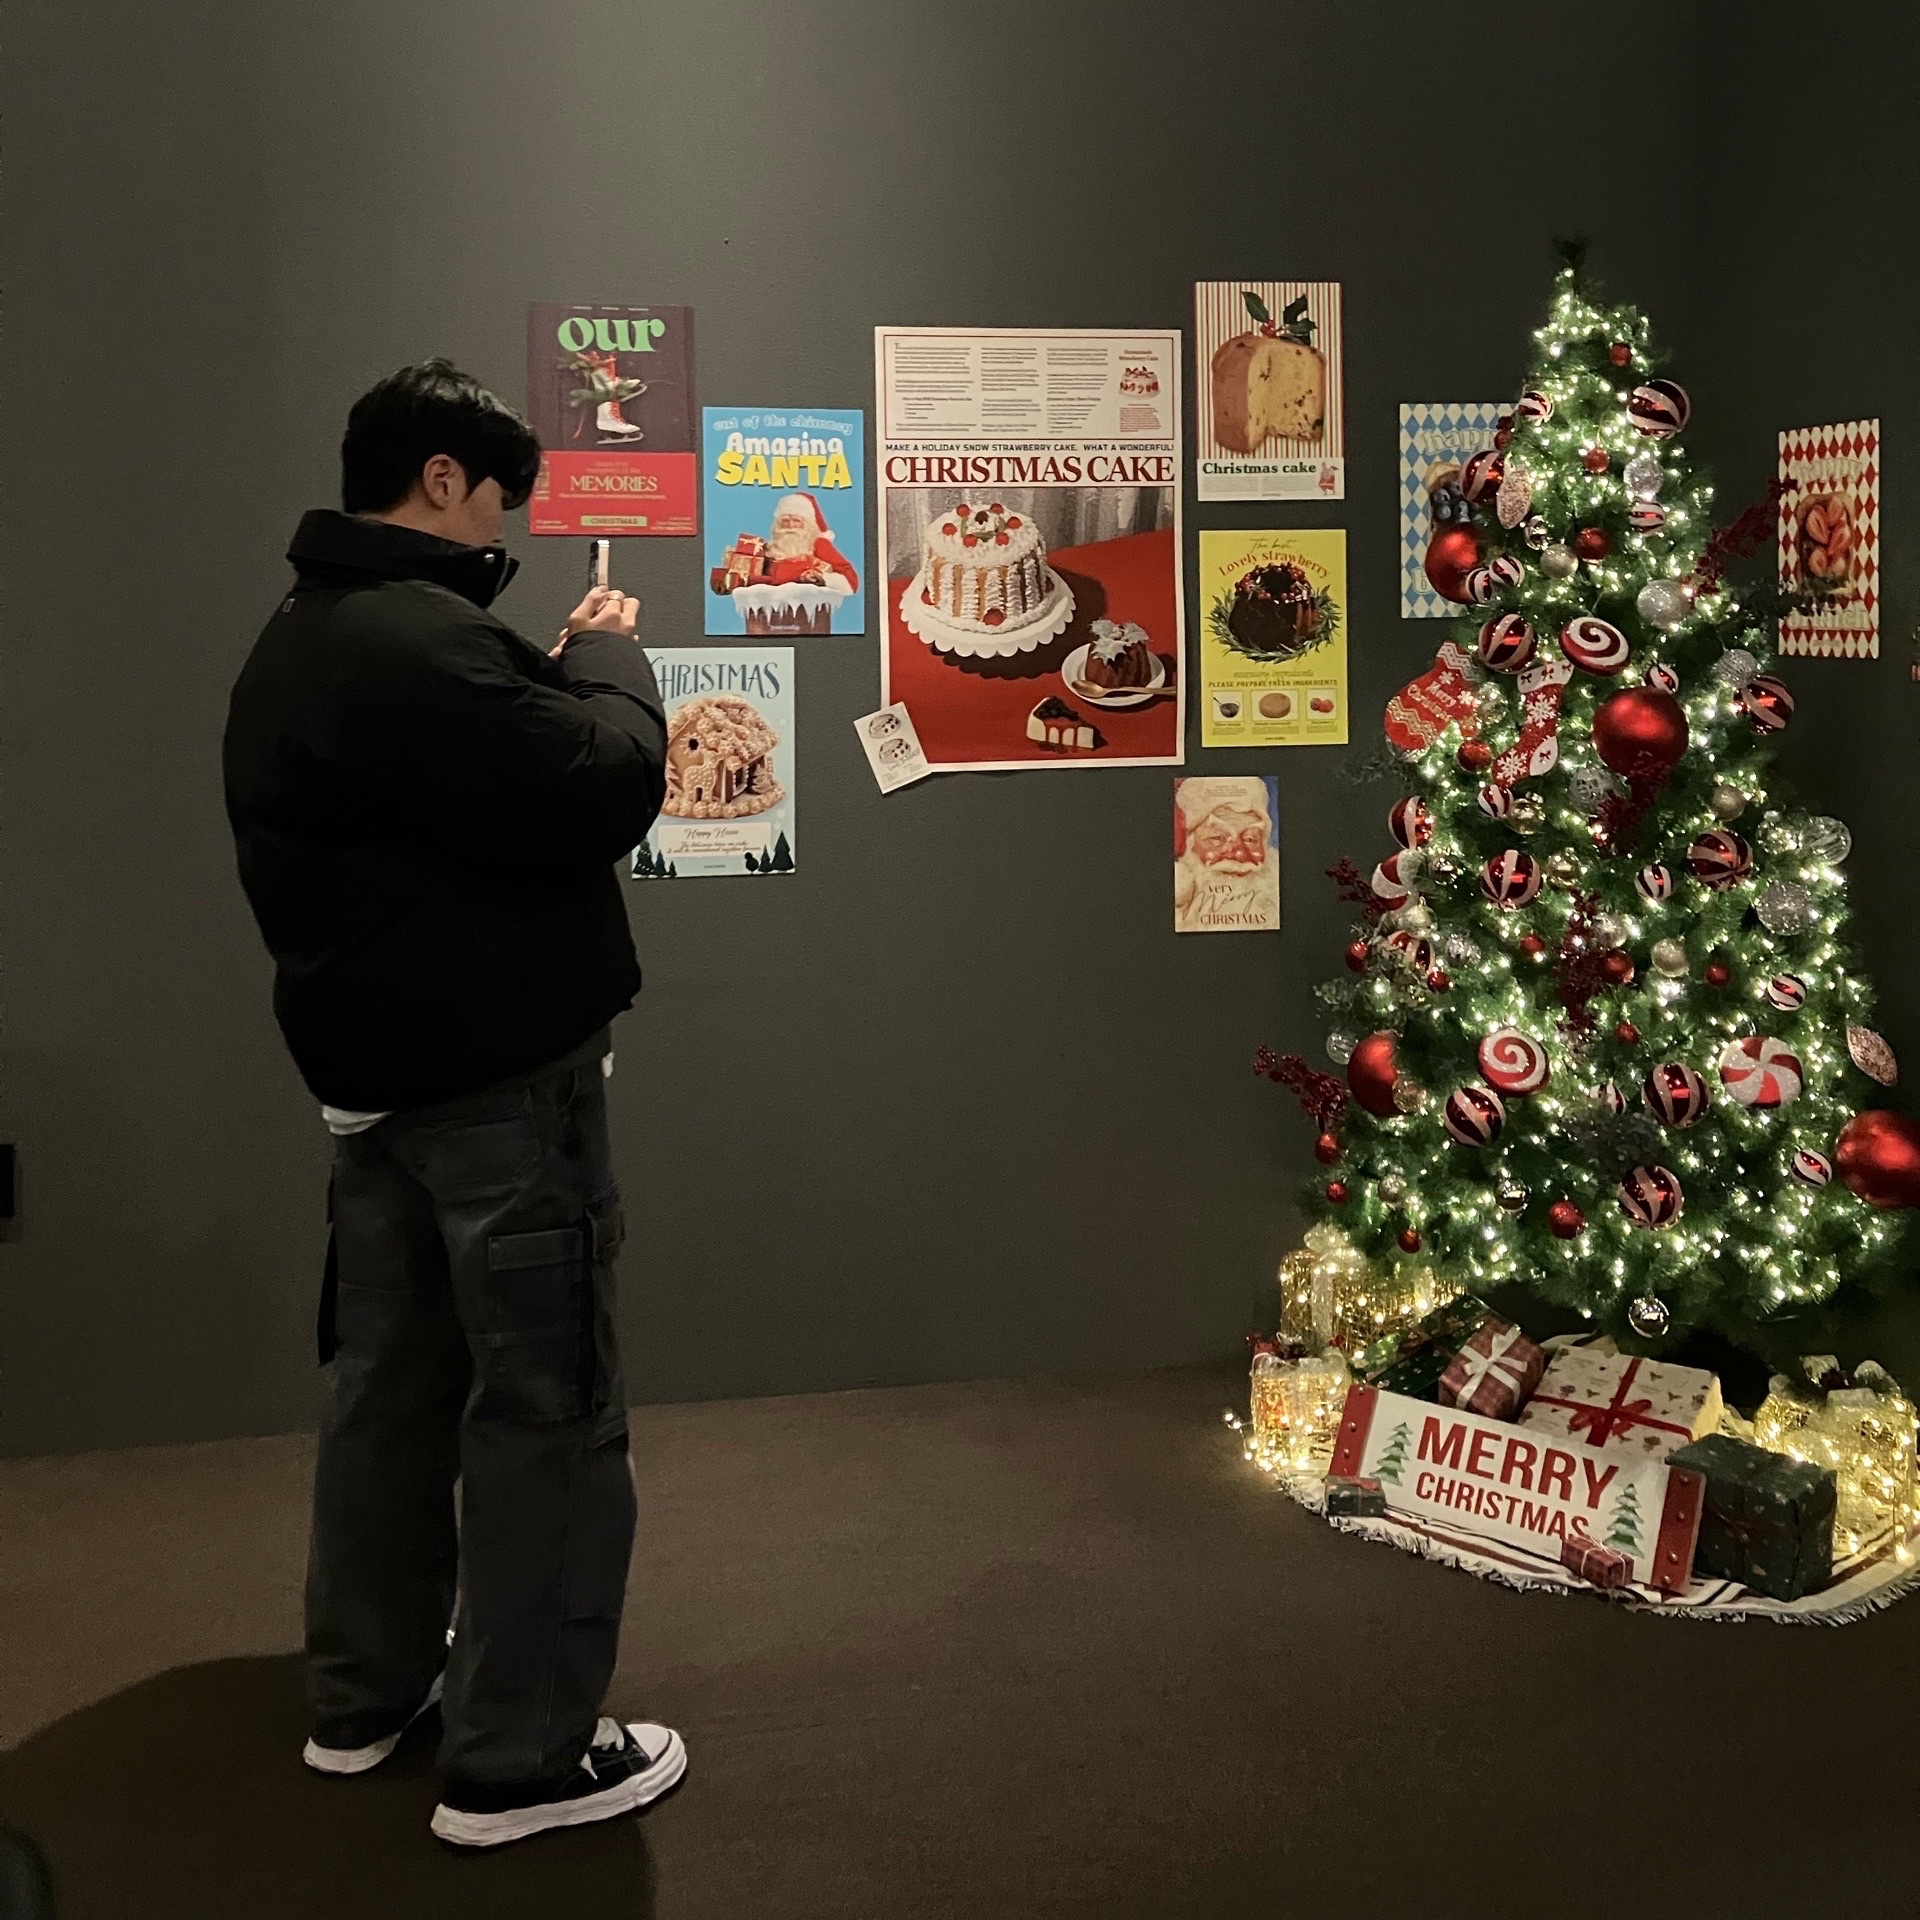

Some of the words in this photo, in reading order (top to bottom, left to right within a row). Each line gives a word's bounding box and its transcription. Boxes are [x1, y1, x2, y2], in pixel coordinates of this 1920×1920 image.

[558, 317, 666, 352] our
[742, 415, 759, 429] of
[763, 414, 787, 427] the
[790, 415, 853, 436] chimney
[726, 431, 845, 456] Amazing
[886, 444, 910, 452] MAKE
[913, 444, 919, 452] A
[922, 444, 960, 452] HOLIDAY
[963, 444, 989, 452] SNOW
[992, 444, 1051, 452] STRAWBERRY
[1083, 444, 1107, 452] WHAT
[1110, 444, 1117, 452] A
[715, 450, 852, 489] SANTA
[885, 456, 1082, 483] CHRISTMAS
[1087, 456, 1175, 483] CAKE
[1202, 462, 1278, 474] Christmas
[1282, 462, 1316, 473] cake
[570, 475, 658, 492] MEMORIES
[1219, 553, 1258, 577] Lovely
[1262, 550, 1331, 579] strawberry
[1209, 885, 1232, 896] very
[1200, 913, 1267, 925] CHRISTMAS
[1417, 1416, 1620, 1510] MERRY
[1416, 1471, 1590, 1541] CHRISTMAS
